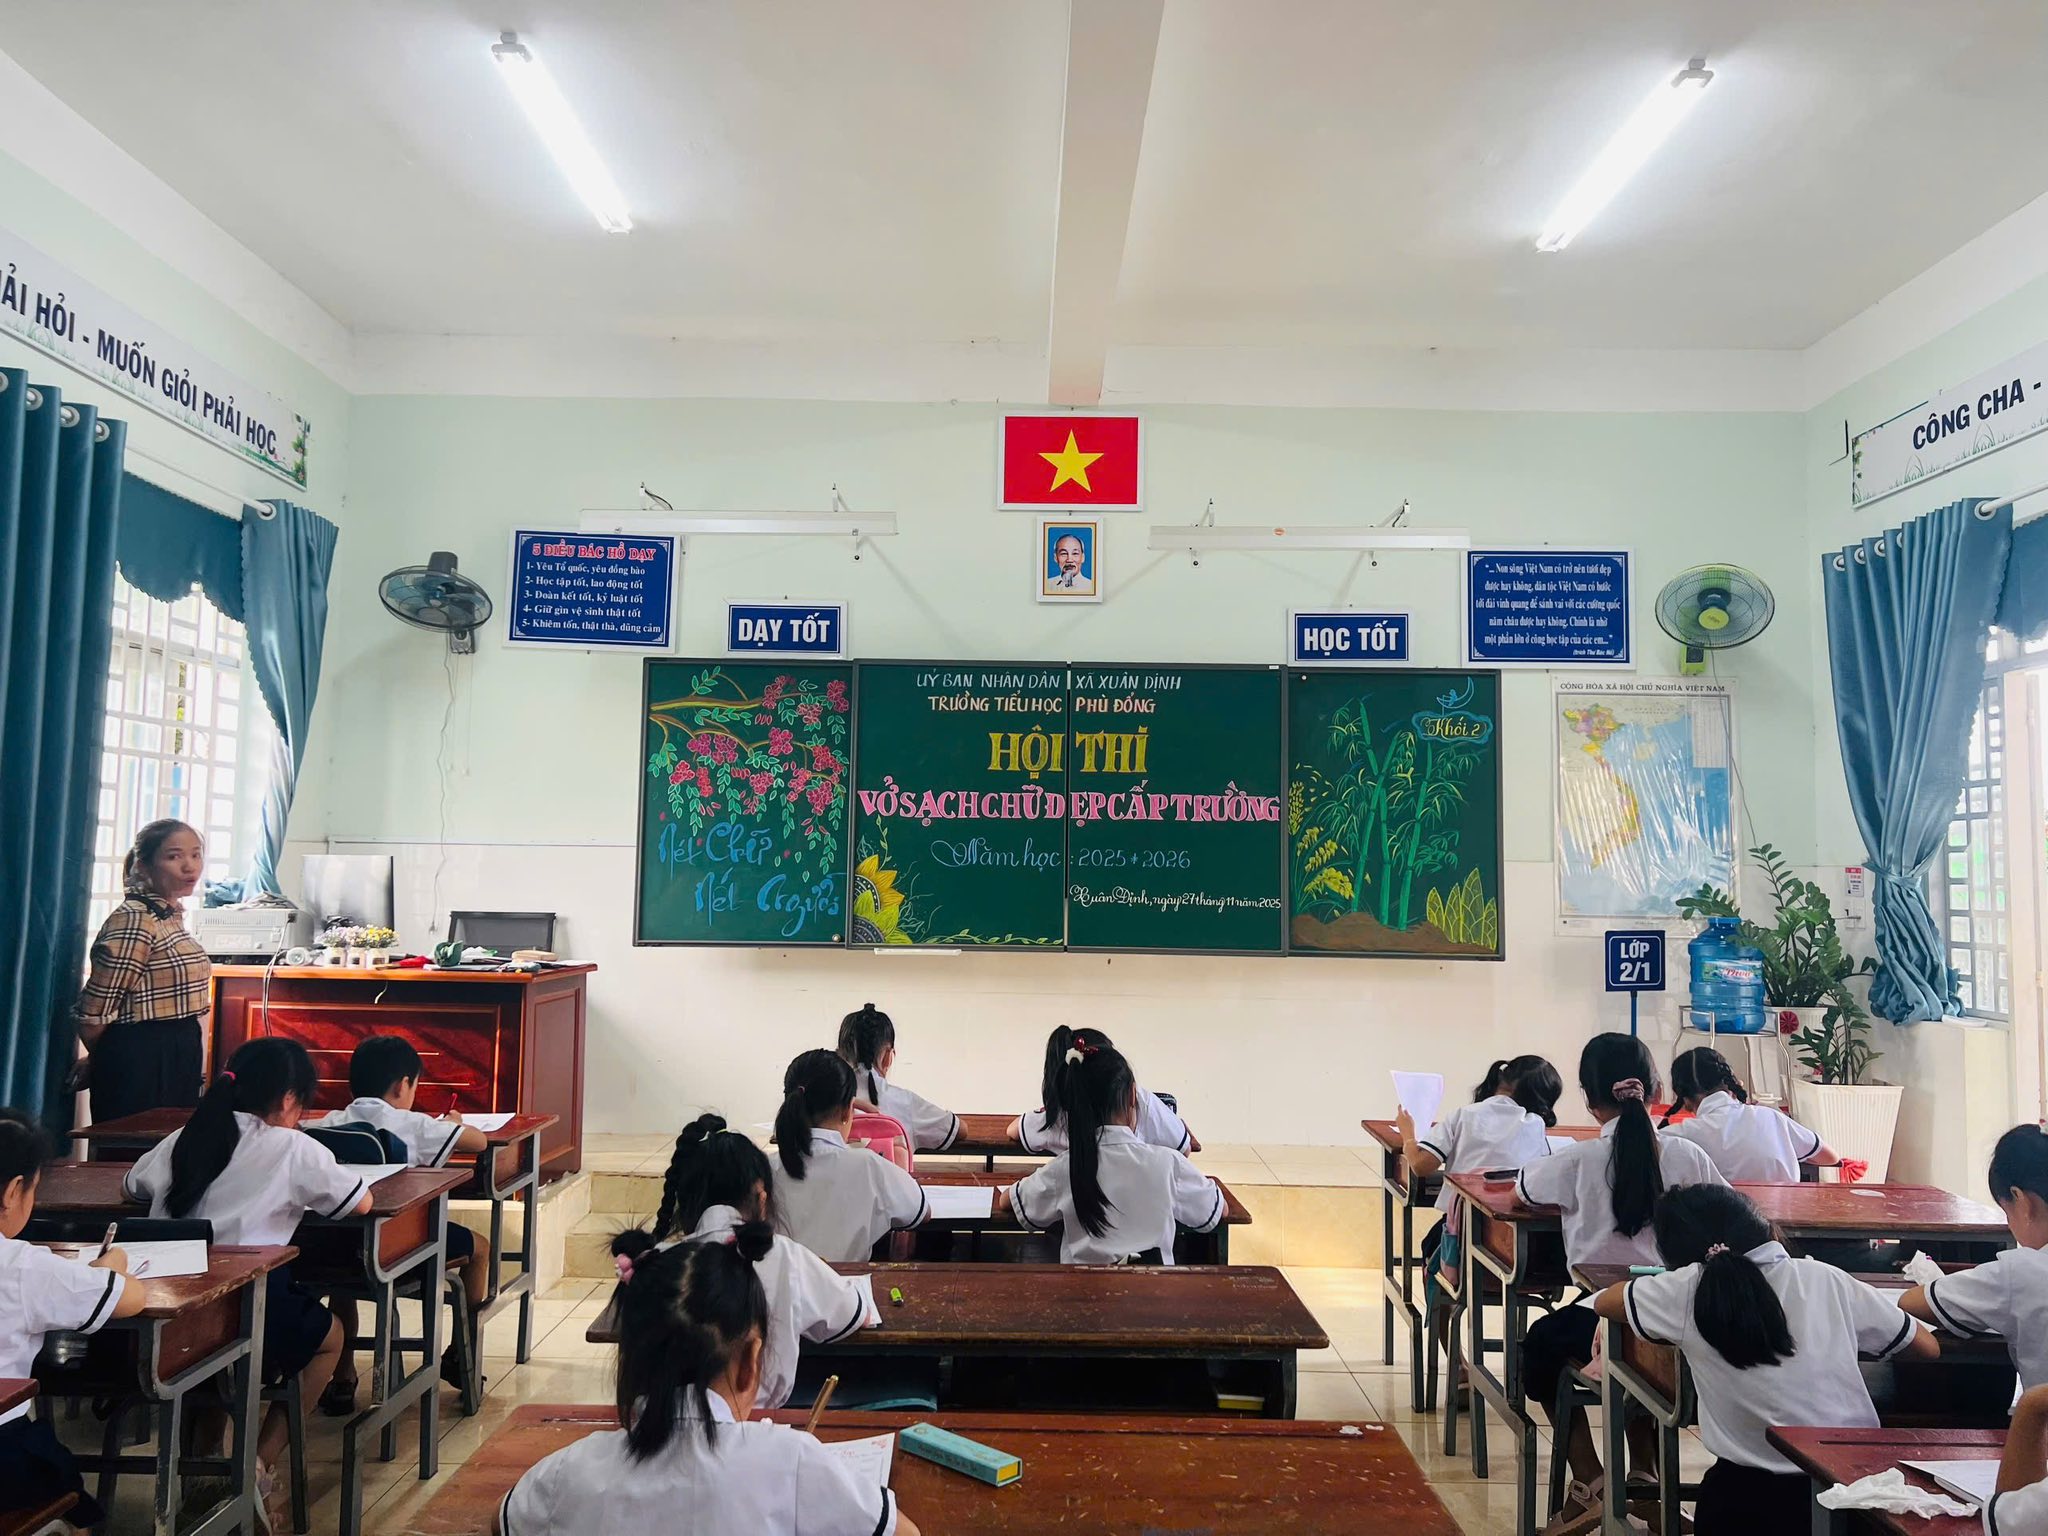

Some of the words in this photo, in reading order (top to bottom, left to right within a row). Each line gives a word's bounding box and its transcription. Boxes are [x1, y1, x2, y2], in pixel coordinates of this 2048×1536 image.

[0, 263, 27, 316] ẢI
[36, 292, 75, 342] HỎI
[97, 328, 155, 388] MUỐN
[162, 368, 197, 411] GIỎI
[203, 391, 240, 436] PHẢI
[246, 416, 276, 455] HỌC
[1913, 404, 1970, 450] CÔNG
[1978, 378, 2024, 420] CHA
[532, 543, 541, 556] 5
[578, 543, 604, 559] BÁC
[628, 547, 656, 563] DẠY
[536, 561, 553, 571] Yêu
[567, 562, 589, 574] quốc,
[592, 564, 606, 575] yêu
[608, 563, 628, 576] đồng
[630, 565, 645, 575] bào
[1525, 562, 1537, 575] Việt
[1539, 563, 1553, 574] Nam
[1600, 563, 1611, 577] đẹp
[536, 576, 553, 587] Học
[556, 577, 571, 588] tập
[573, 576, 588, 588] tốt,
[591, 578, 604, 588] lao
[606, 579, 628, 590] động
[630, 579, 643, 590] tốt
[1501, 581, 1511, 593] hay
[1535, 581, 1546, 591] dân
[1559, 581, 1571, 593] Việt
[1573, 581, 1587, 592] Nam
[535, 590, 559, 600] Đoàn
[562, 590, 576, 601] kết
[579, 591, 594, 602] tốt,
[597, 592, 607, 604] kỷ
[610, 593, 627, 604] luật
[630, 593, 643, 604] tốt
[1511, 600, 1529, 611] quang
[1555, 598, 1563, 609] vai
[1576, 598, 1586, 609] các
[534, 604, 553, 614] Giữ
[554, 605, 568, 616] gìn
[571, 606, 582, 617] vệ
[585, 606, 603, 616] sinh
[606, 607, 624, 618] thật
[628, 607, 640, 618] tốt
[533, 618, 561, 629] Khiêm
[563, 619, 579, 630] tốn,
[582, 621, 599, 632] thật
[602, 621, 618, 632] thà,
[620, 622, 641, 634] dũng
[643, 622, 660, 633] cảm
[739, 618, 783, 647] DẠY
[790, 612, 830, 643] TỐT
[1536, 616, 1545, 629] hay
[1570, 616, 1587, 627] Chính
[1304, 627, 1350, 656] HỌC
[1358, 620, 1399, 651] TỐT
[1547, 633, 1557, 646] học
[1582, 633, 1592, 645] các
[942, 673, 973, 687] BAN
[981, 671, 1025, 688] NHÂN
[1028, 670, 1060, 689] DÂN
[1076, 671, 1094, 689] XÃ
[1098, 671, 1139, 689] XUÂN
[928, 690, 990, 711] TRƯỜNG
[994, 689, 1028, 712] TIỂU
[1031, 698, 1062, 715] HỌC
[1076, 694, 1108, 713] PHÙ
[1113, 691, 1156, 714] ĐỔNG
[1421, 716, 1468, 740] Khối
[1471, 723, 1480, 737] 2
[987, 724, 1065, 780] HỘI
[1075, 725, 1149, 773] THI
[857, 775, 899, 817] VỞ
[900, 789, 980, 827] SẠCH
[981, 784, 1044, 820] CHỮ
[1107, 780, 1168, 821] CẤP
[1170, 780, 1280, 822] TRƯỜNG
[706, 821, 772, 865] Chữ
[930, 837, 1019, 868] Năm
[1023, 837, 1061, 872] học
[1070, 884, 1113, 908] Xuân
[1153, 893, 1182, 912] ngày
[1182, 892, 1196, 905] 27
[1196, 891, 1225, 913] tháng
[1226, 896, 1234, 906] 11
[1235, 897, 1260, 908] năm
[1260, 897, 1281, 909] 2025
[1621, 939, 1650, 959] LỚP
[1620, 961, 1650, 982] 2/1
